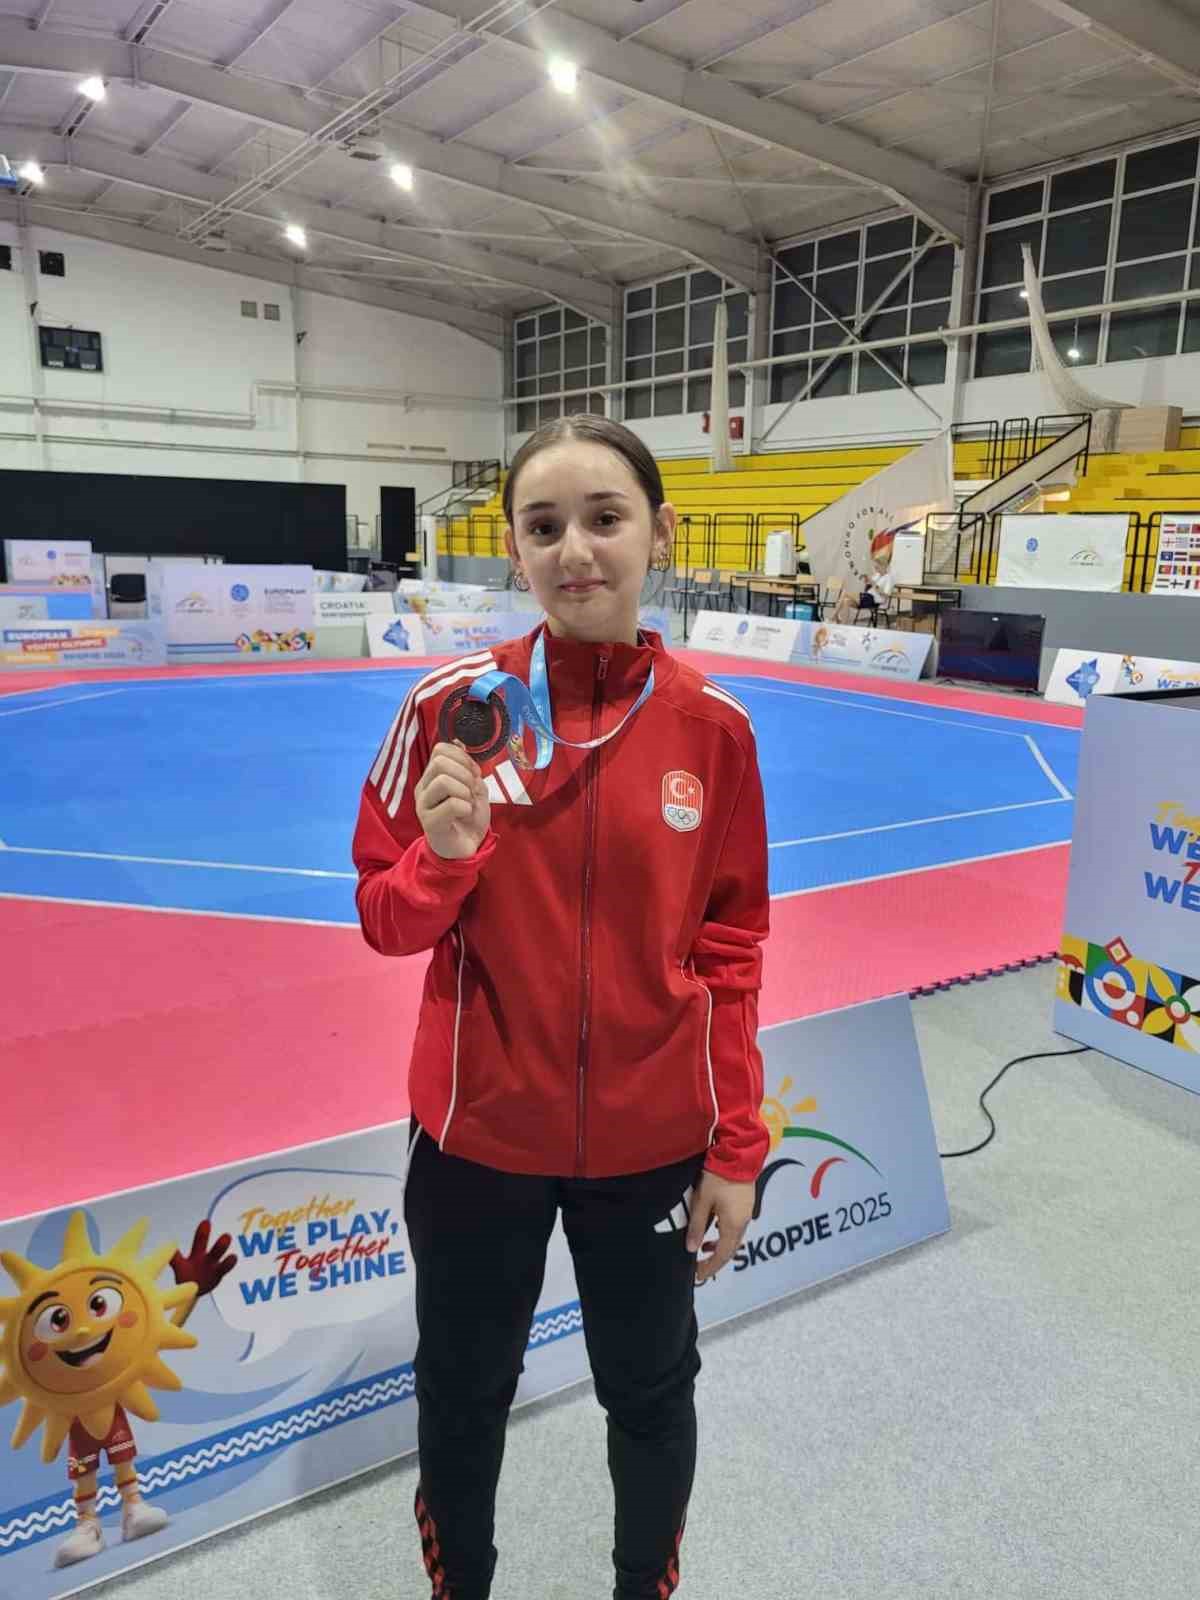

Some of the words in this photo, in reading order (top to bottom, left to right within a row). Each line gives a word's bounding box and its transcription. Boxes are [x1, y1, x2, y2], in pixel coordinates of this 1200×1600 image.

[320, 601, 365, 611] CROATIA
[1144, 872, 1200, 912] WE
[238, 1194, 356, 1236] Together
[238, 1227, 297, 1258] WE
[307, 1209, 399, 1247] PLAY,
[733, 1213, 833, 1272] SKOPJE
[835, 1191, 893, 1233] 2025
[239, 1272, 299, 1306] WE
[308, 1251, 407, 1292] SHINE
[275, 1235, 391, 1279] Together
